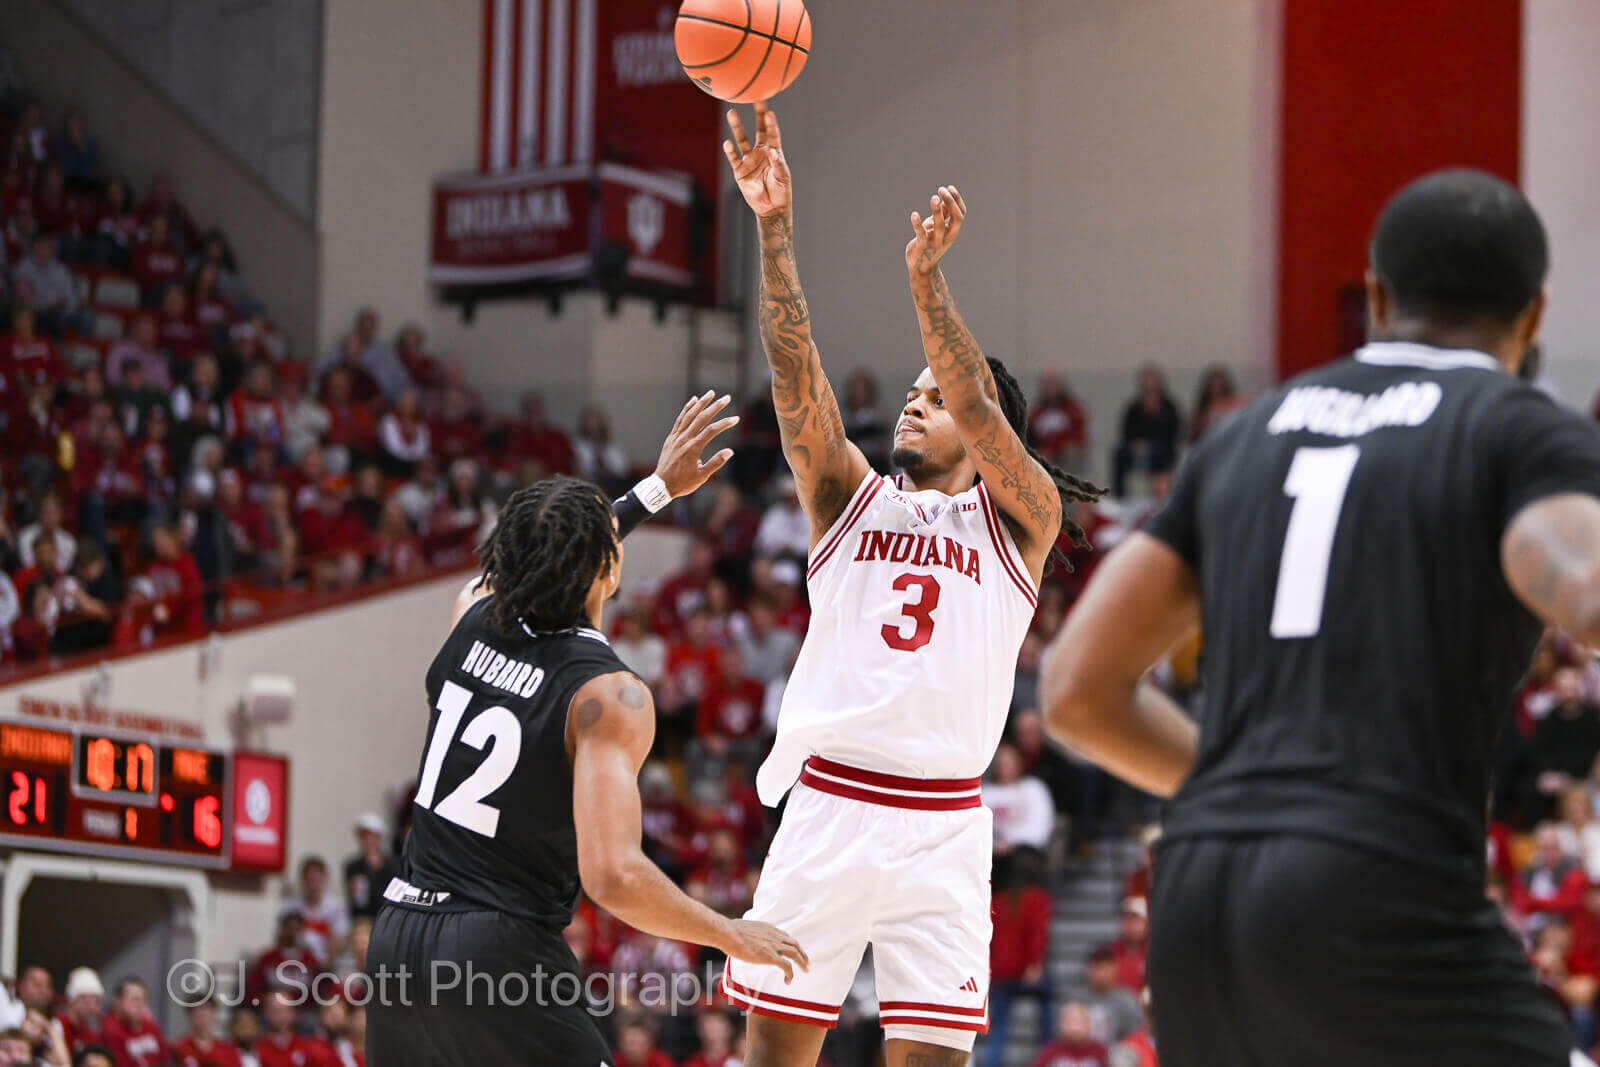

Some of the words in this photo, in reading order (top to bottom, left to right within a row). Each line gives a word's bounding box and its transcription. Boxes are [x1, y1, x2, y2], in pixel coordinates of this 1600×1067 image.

[853, 530, 981, 586] INDIANA
[1270, 444, 1360, 639] 1
[881, 572, 941, 652] 3
[461, 639, 545, 699] HUBBARD
[413, 680, 522, 839] 12
[9, 771, 47, 825] 21
[125, 807, 138, 840] 1
